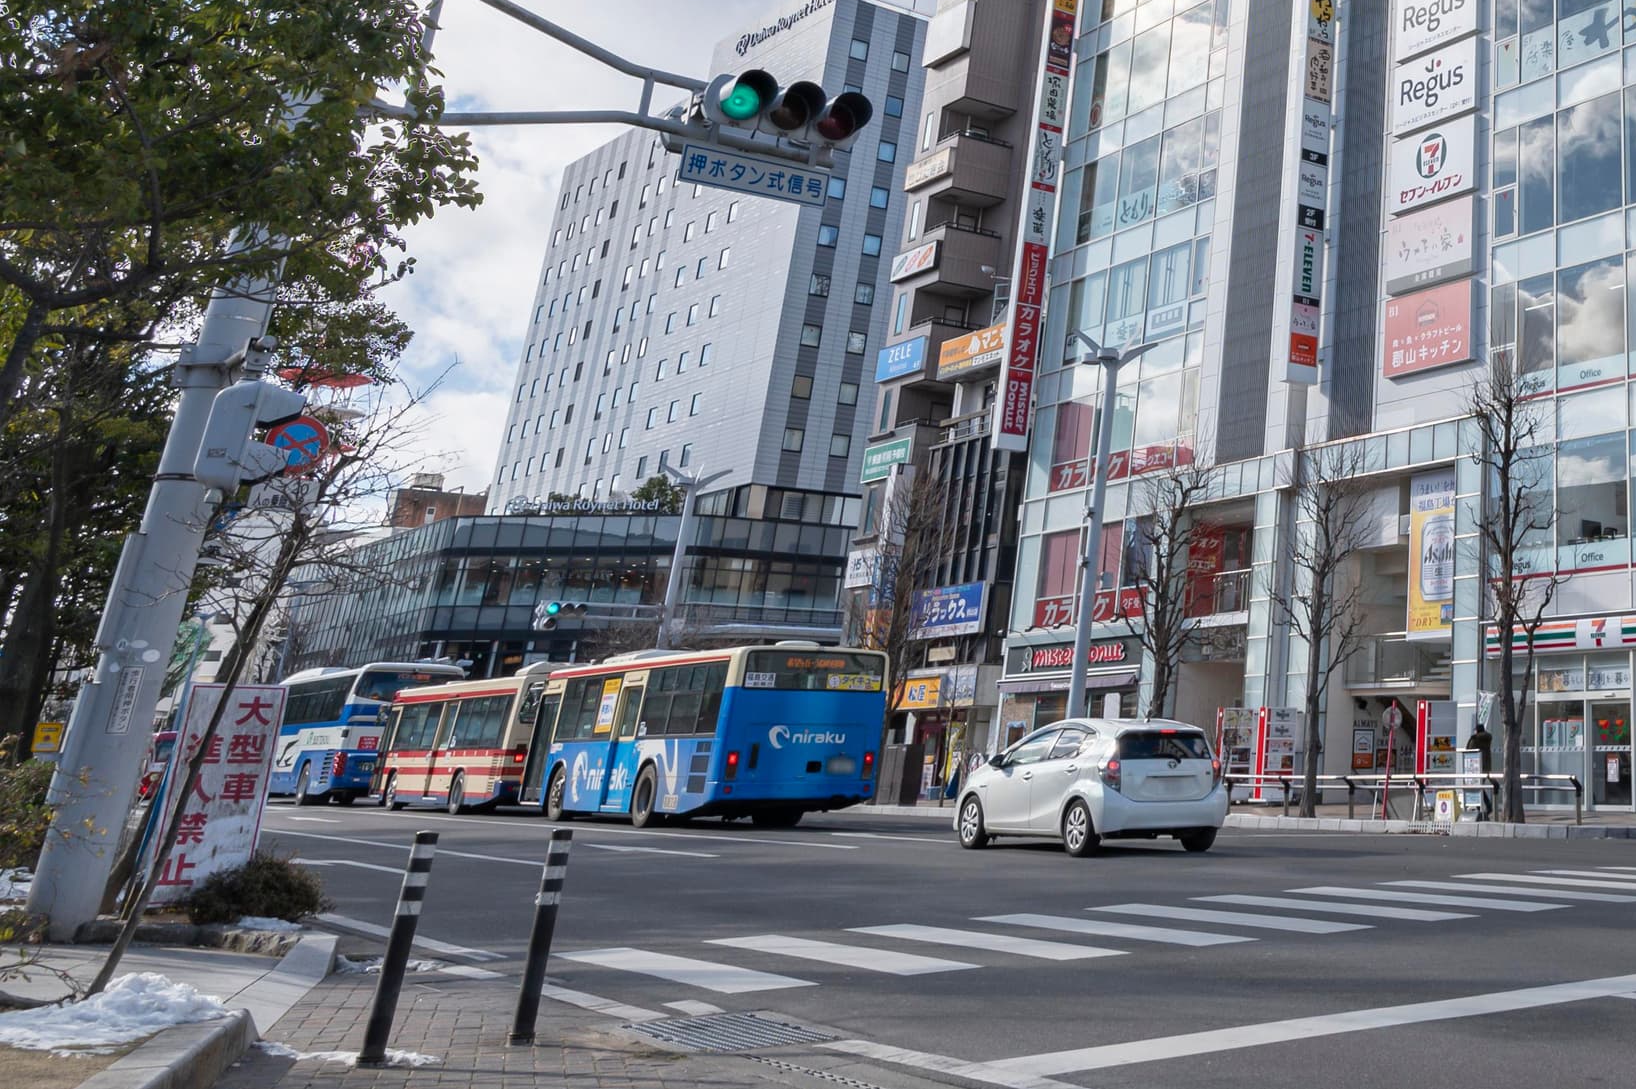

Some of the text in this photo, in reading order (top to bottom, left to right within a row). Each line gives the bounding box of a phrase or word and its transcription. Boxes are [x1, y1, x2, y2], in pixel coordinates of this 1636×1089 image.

[1400, 65, 1464, 108] Regus
[1305, 114, 1325, 128] Regus
[686, 153, 823, 198] 押ボタン式信号
[1302, 174, 1322, 187] Regus
[1027, 252, 1041, 304] ビッグエコー
[1015, 306, 1035, 369] カラオケ
[888, 344, 912, 364] ZELE
[1392, 339, 1462, 368] 郡山キッチン
[1524, 380, 1546, 392] Regus
[1579, 367, 1602, 380] Office
[1015, 382, 1029, 433] mister
[1058, 455, 1123, 490] カラケ
[621, 497, 660, 512] Hotel
[1513, 562, 1531, 574] egus
[1581, 551, 1604, 563] Office
[1042, 595, 1110, 625] カラケ
[1591, 619, 1607, 647] 7
[1034, 642, 1125, 667] miste onut
[909, 685, 926, 701] 松屋
[792, 729, 846, 744] niraku
[219, 696, 274, 805] 大型車
